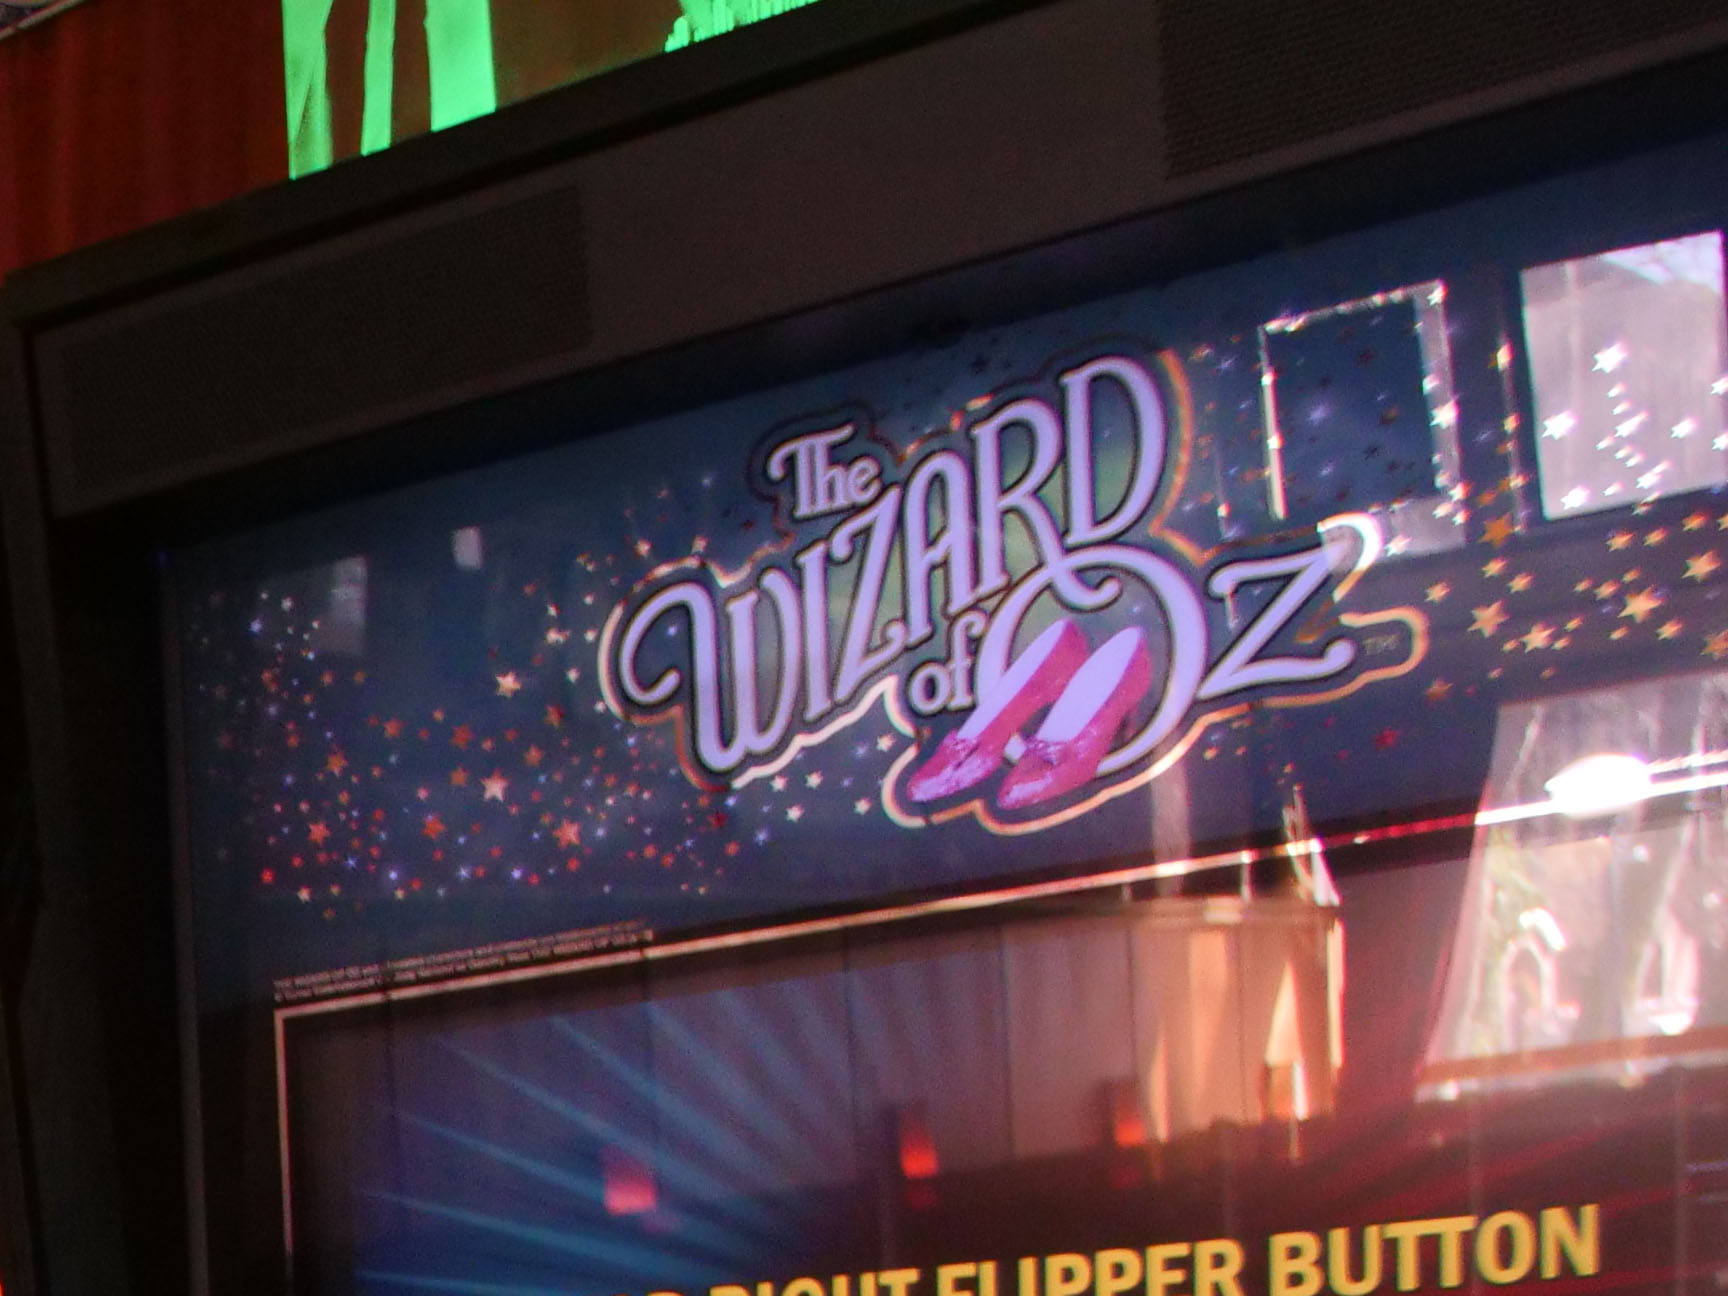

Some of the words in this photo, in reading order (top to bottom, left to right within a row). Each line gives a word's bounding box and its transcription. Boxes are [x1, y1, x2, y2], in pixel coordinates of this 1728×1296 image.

[770, 424, 881, 519] The
[620, 354, 1167, 773] WIZARD
[909, 612, 986, 715] of
